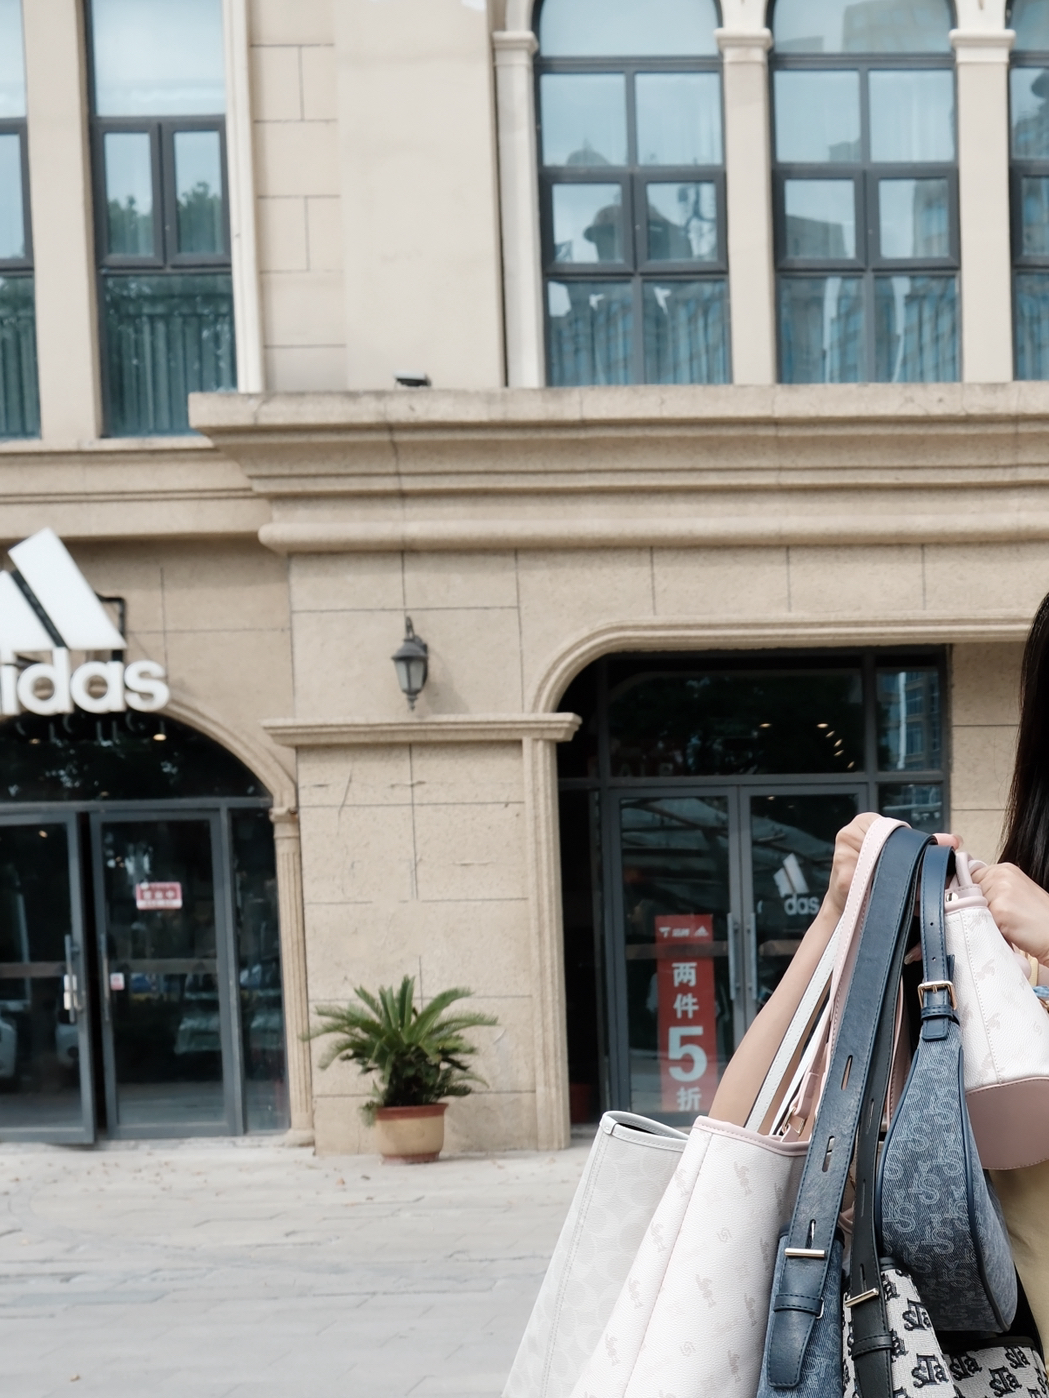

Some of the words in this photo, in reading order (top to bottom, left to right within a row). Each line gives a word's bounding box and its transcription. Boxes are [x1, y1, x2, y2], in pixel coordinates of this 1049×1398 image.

[902, 1298, 932, 1331] sTa
[911, 1353, 949, 1388] sTa
[988, 1365, 1023, 1398] sTa
